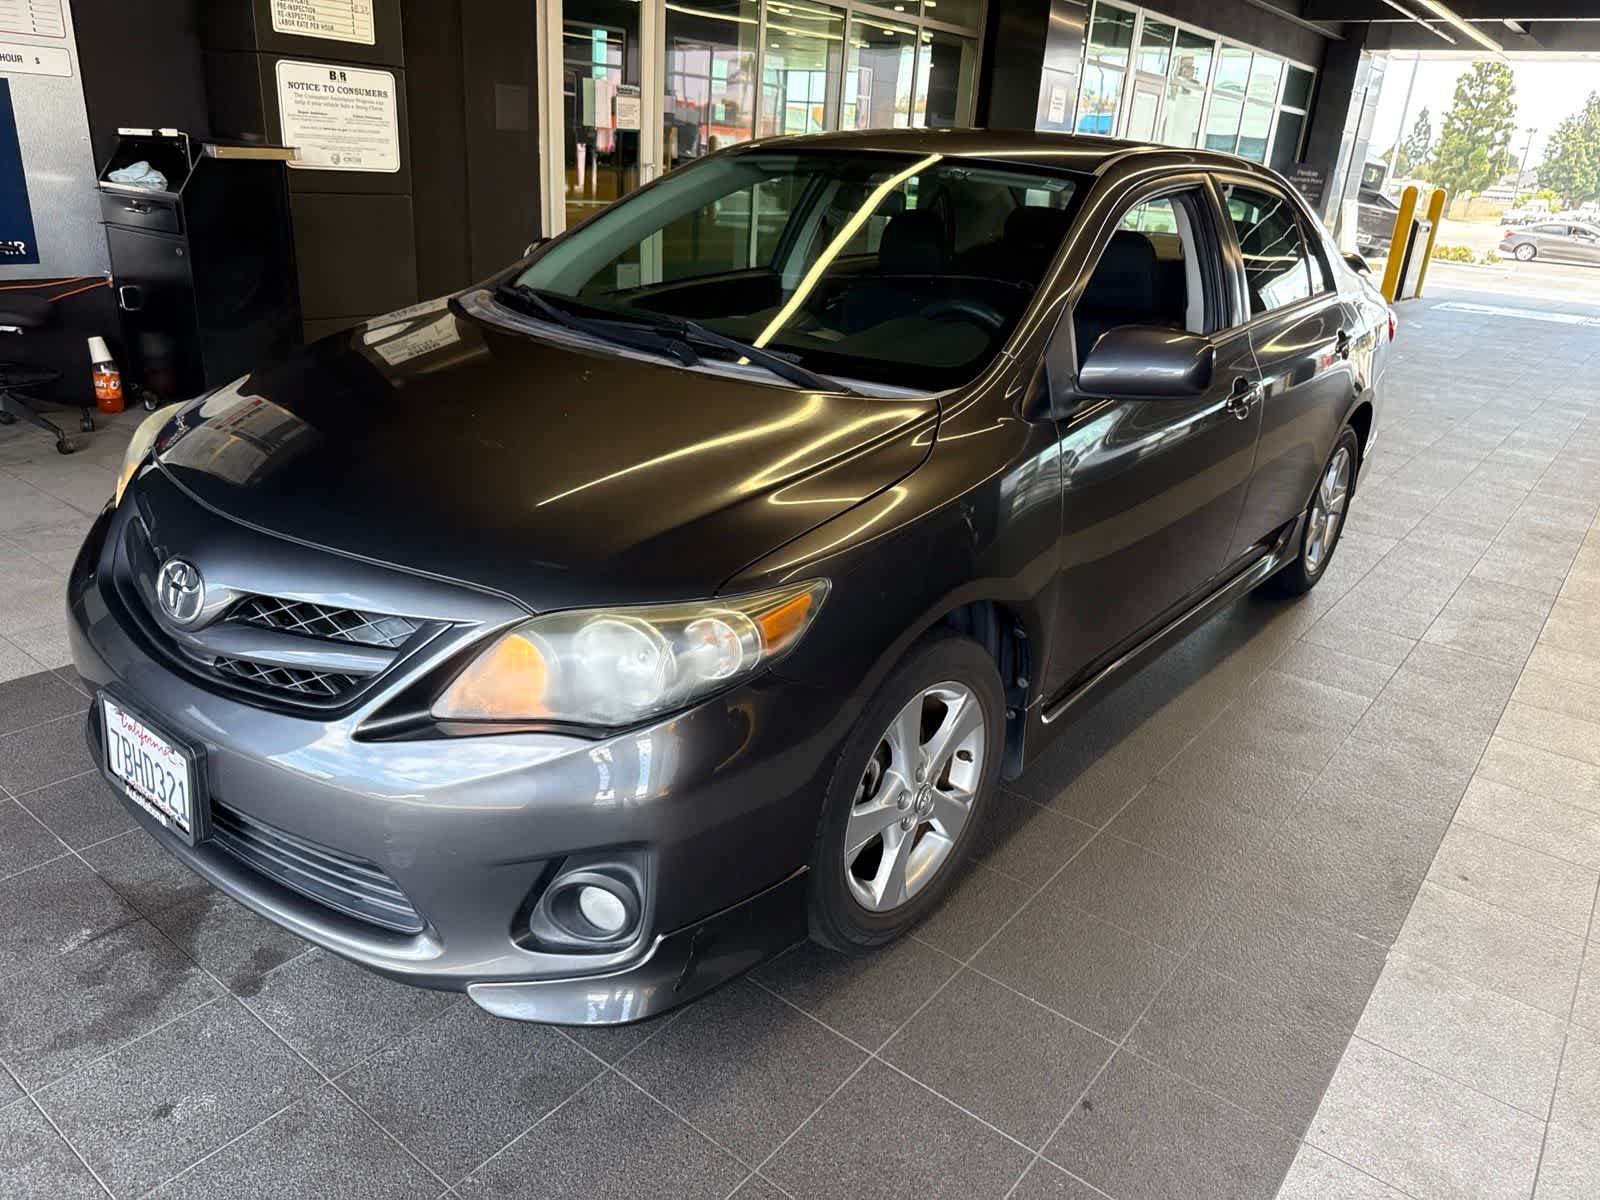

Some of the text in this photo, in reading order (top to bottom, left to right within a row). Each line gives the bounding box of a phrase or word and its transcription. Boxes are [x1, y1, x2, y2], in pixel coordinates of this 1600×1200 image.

[0, 53, 23, 63] HOUR
[287, 81, 389, 98] NOTICE TO CONSUMERS
[110, 727, 188, 821] 7BHD321
